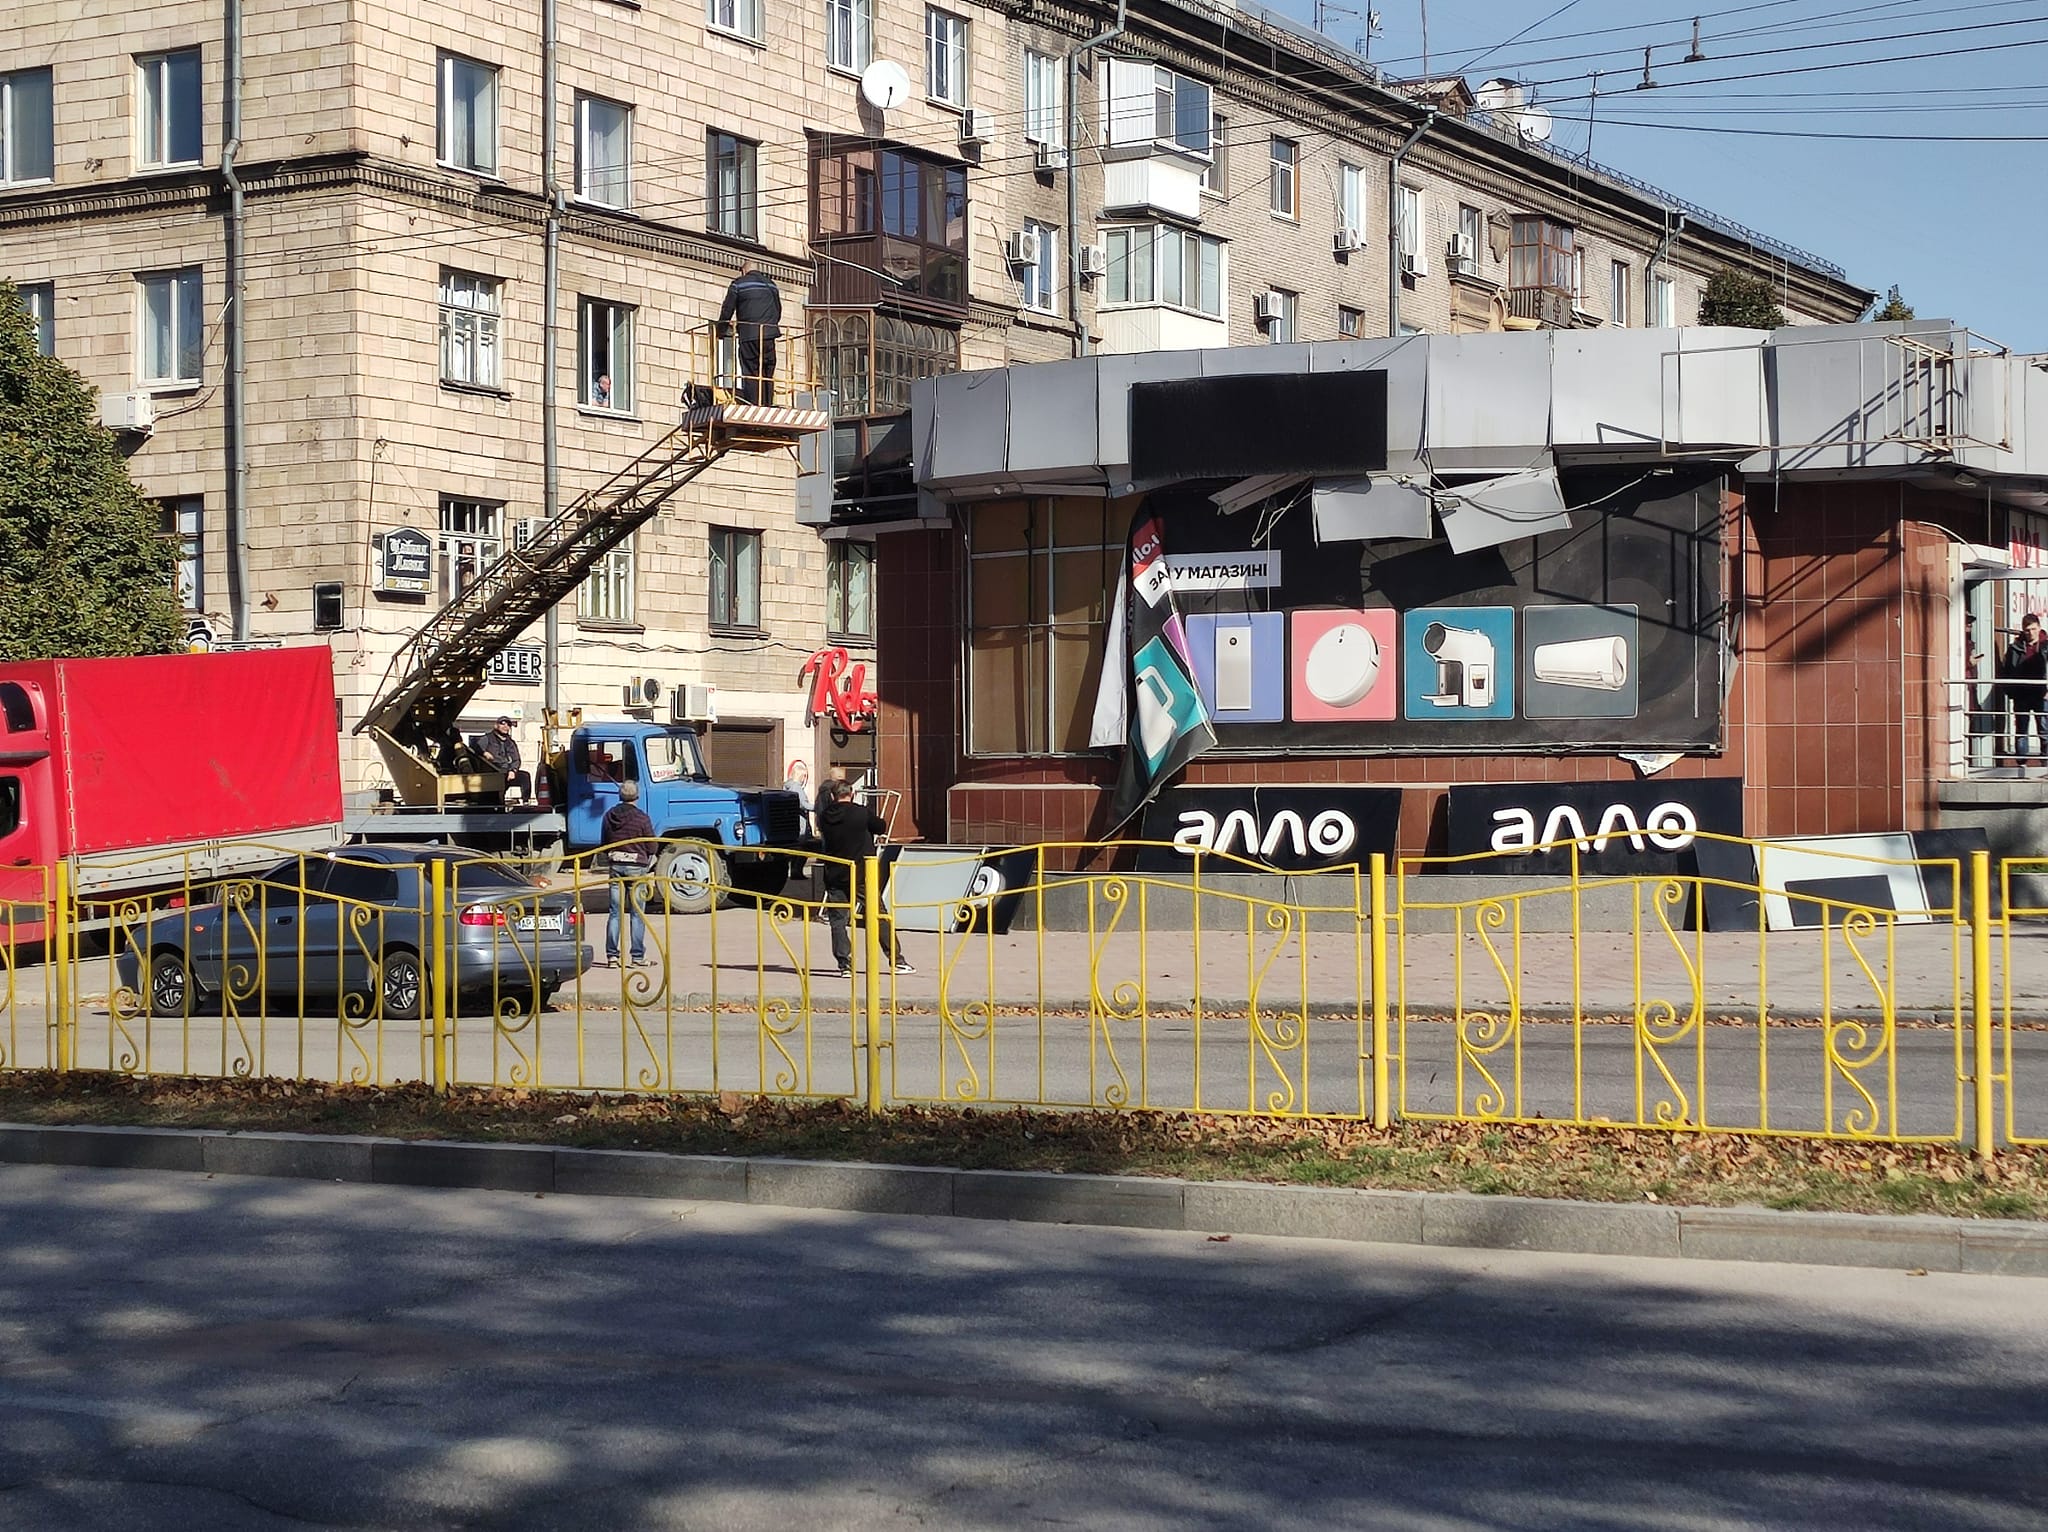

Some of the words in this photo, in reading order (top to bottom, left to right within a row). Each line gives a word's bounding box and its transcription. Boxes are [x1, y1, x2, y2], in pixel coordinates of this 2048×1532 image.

[1174, 567, 1185, 580] У
[1188, 563, 1268, 579] МАГАЗИНІ
[493, 651, 542, 675] BEER
